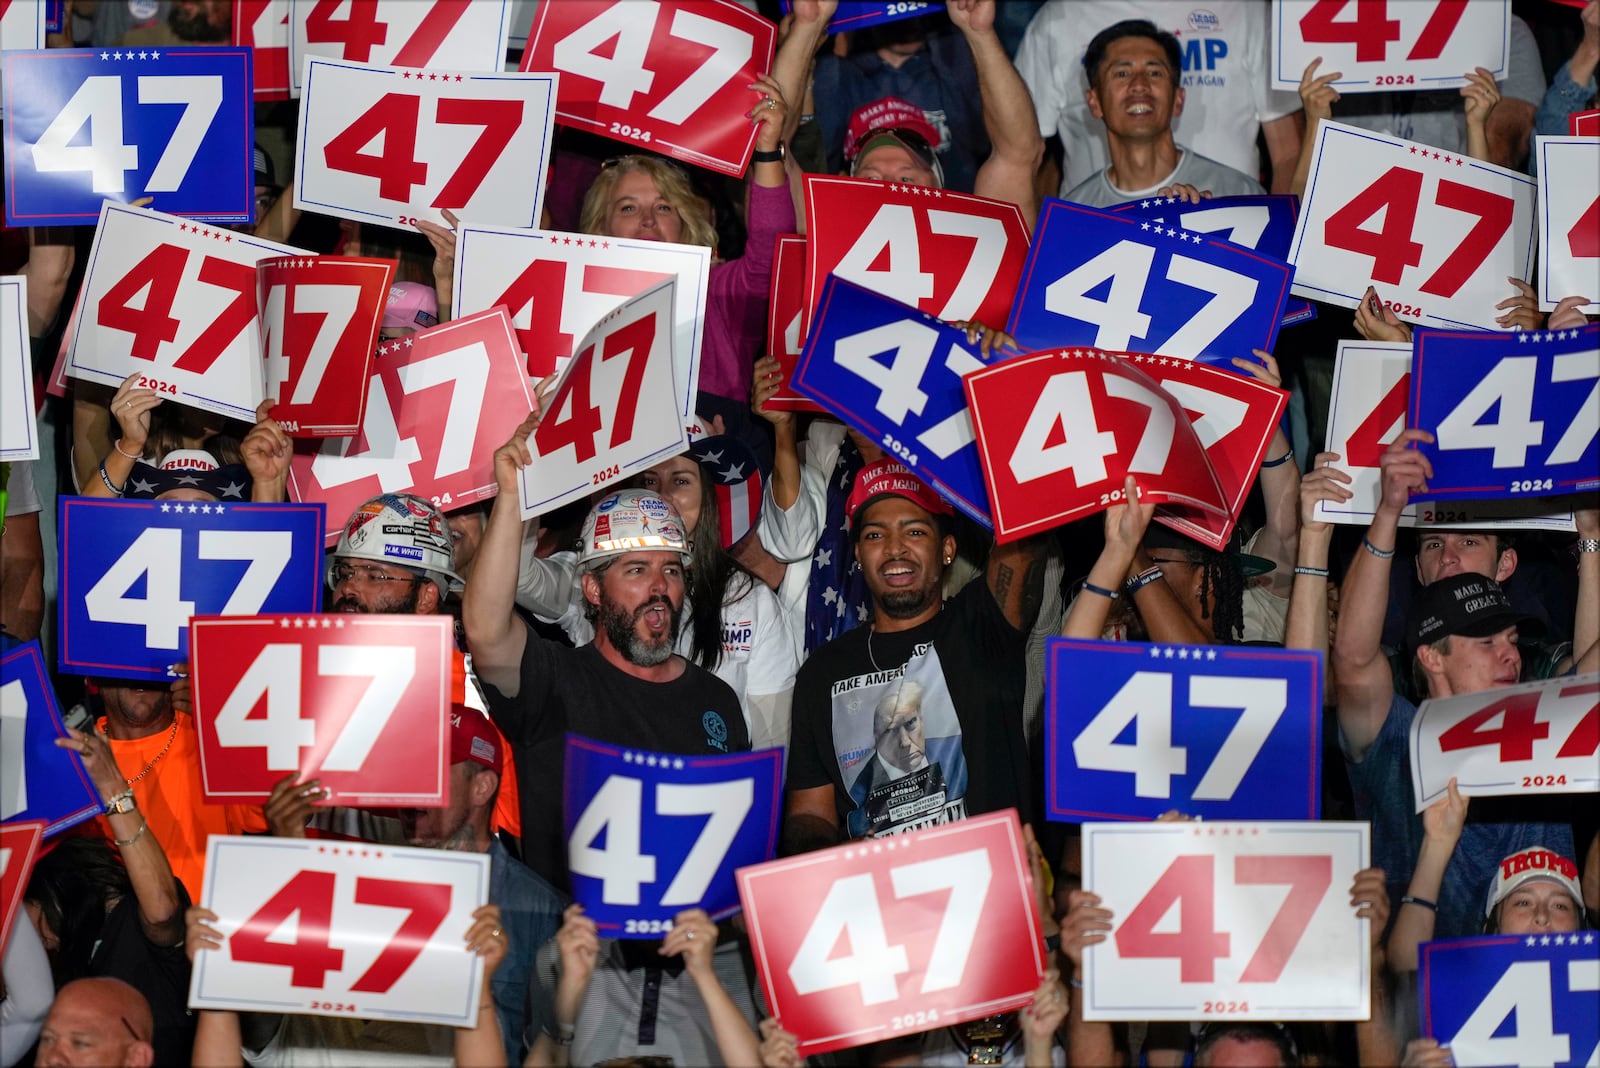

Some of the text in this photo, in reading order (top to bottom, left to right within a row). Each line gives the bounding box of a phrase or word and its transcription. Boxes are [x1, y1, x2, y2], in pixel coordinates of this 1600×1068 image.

[553, 0, 754, 126] 47
[1375, 75, 1416, 86] 2024
[32, 75, 223, 193] 47
[610, 122, 652, 143] 2024
[323, 91, 525, 209] 47
[399, 215, 418, 226] 20
[1324, 166, 1515, 301] 47
[833, 204, 1008, 322] 47
[97, 243, 258, 375] 47
[1045, 240, 1259, 362] 47
[1383, 301, 1422, 318] 2024
[260, 284, 361, 405] 47
[138, 376, 177, 395] 2024
[534, 312, 656, 464] 47
[311, 341, 491, 494] 47
[1436, 348, 1600, 469] 47
[279, 420, 299, 433] 024
[1008, 371, 1175, 488] 47
[882, 434, 919, 467] 2024
[592, 464, 620, 485] 2024
[863, 466, 883, 484] MAKE
[1510, 479, 1553, 493] 2024
[430, 492, 453, 507] 24
[641, 504, 669, 512] TRUMP
[1423, 511, 1467, 522] 2024
[401, 547, 423, 557] WHITE
[85, 527, 292, 650] 47
[1454, 583, 1483, 600] MAKE
[1465, 594, 1498, 613] GREAT
[722, 628, 752, 644] UMP
[833, 677, 862, 695] TAKE
[214, 643, 416, 771] 47
[1438, 682, 1600, 763] 47
[1072, 671, 1288, 801] 47
[1522, 775, 1567, 788] 2024
[568, 774, 754, 906] 47
[1500, 850, 1579, 881] TRUMP
[229, 870, 453, 994] 47
[625, 920, 673, 934] 2024
[787, 847, 993, 1006] 47
[1114, 855, 1333, 984] 47
[310, 1001, 357, 1012] 2024
[1203, 1001, 1250, 1014] 2024
[892, 1009, 939, 1031] 2024
